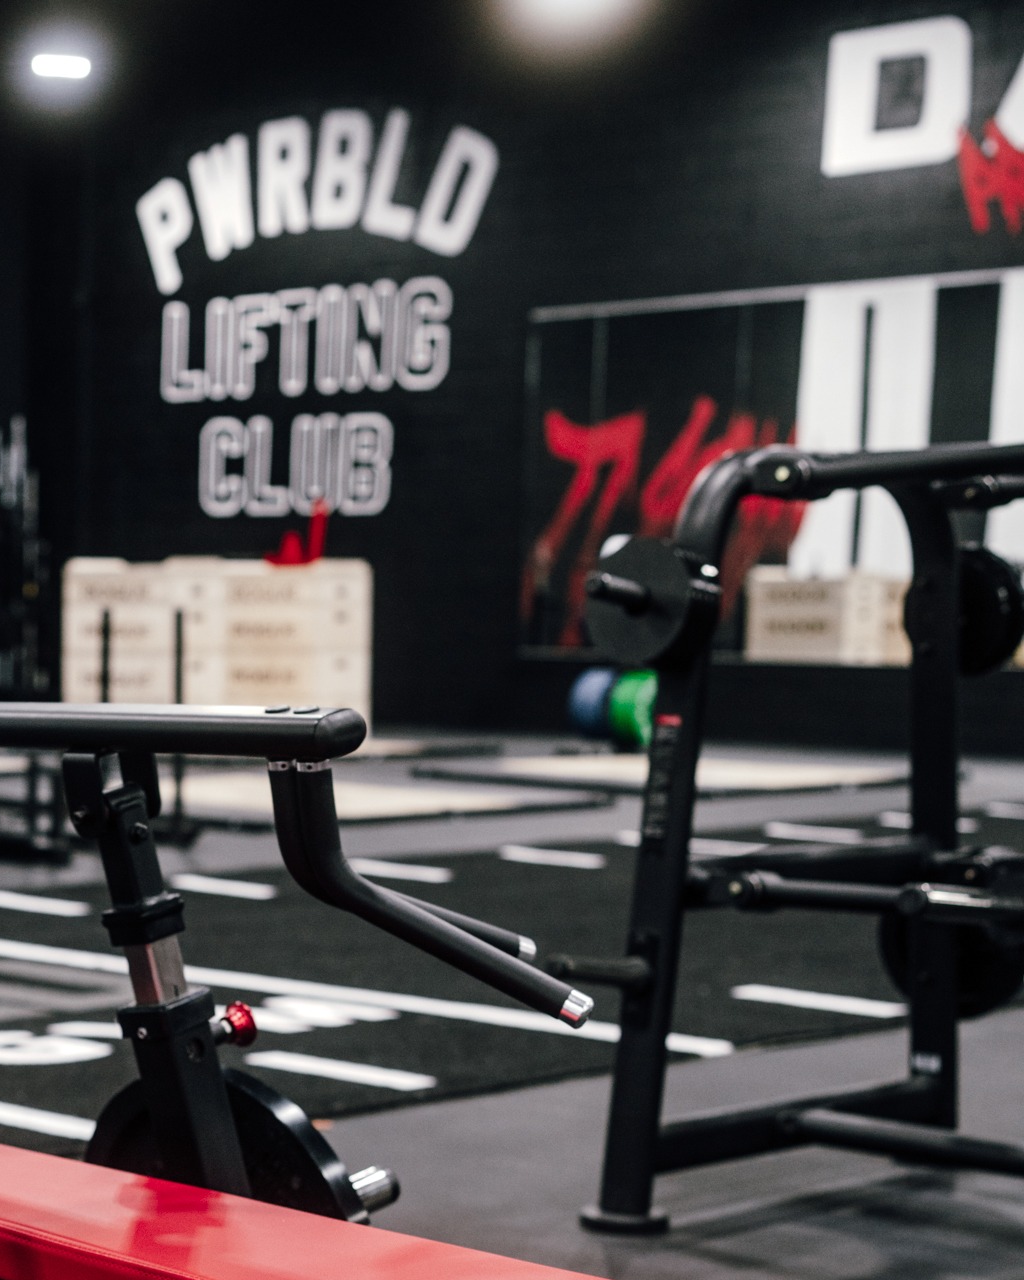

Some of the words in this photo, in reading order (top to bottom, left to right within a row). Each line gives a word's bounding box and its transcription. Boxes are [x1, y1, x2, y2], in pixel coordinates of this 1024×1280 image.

[136, 107, 499, 294] PWRBLD
[160, 276, 453, 403] LIFTING
[199, 411, 394, 518] CLUB
